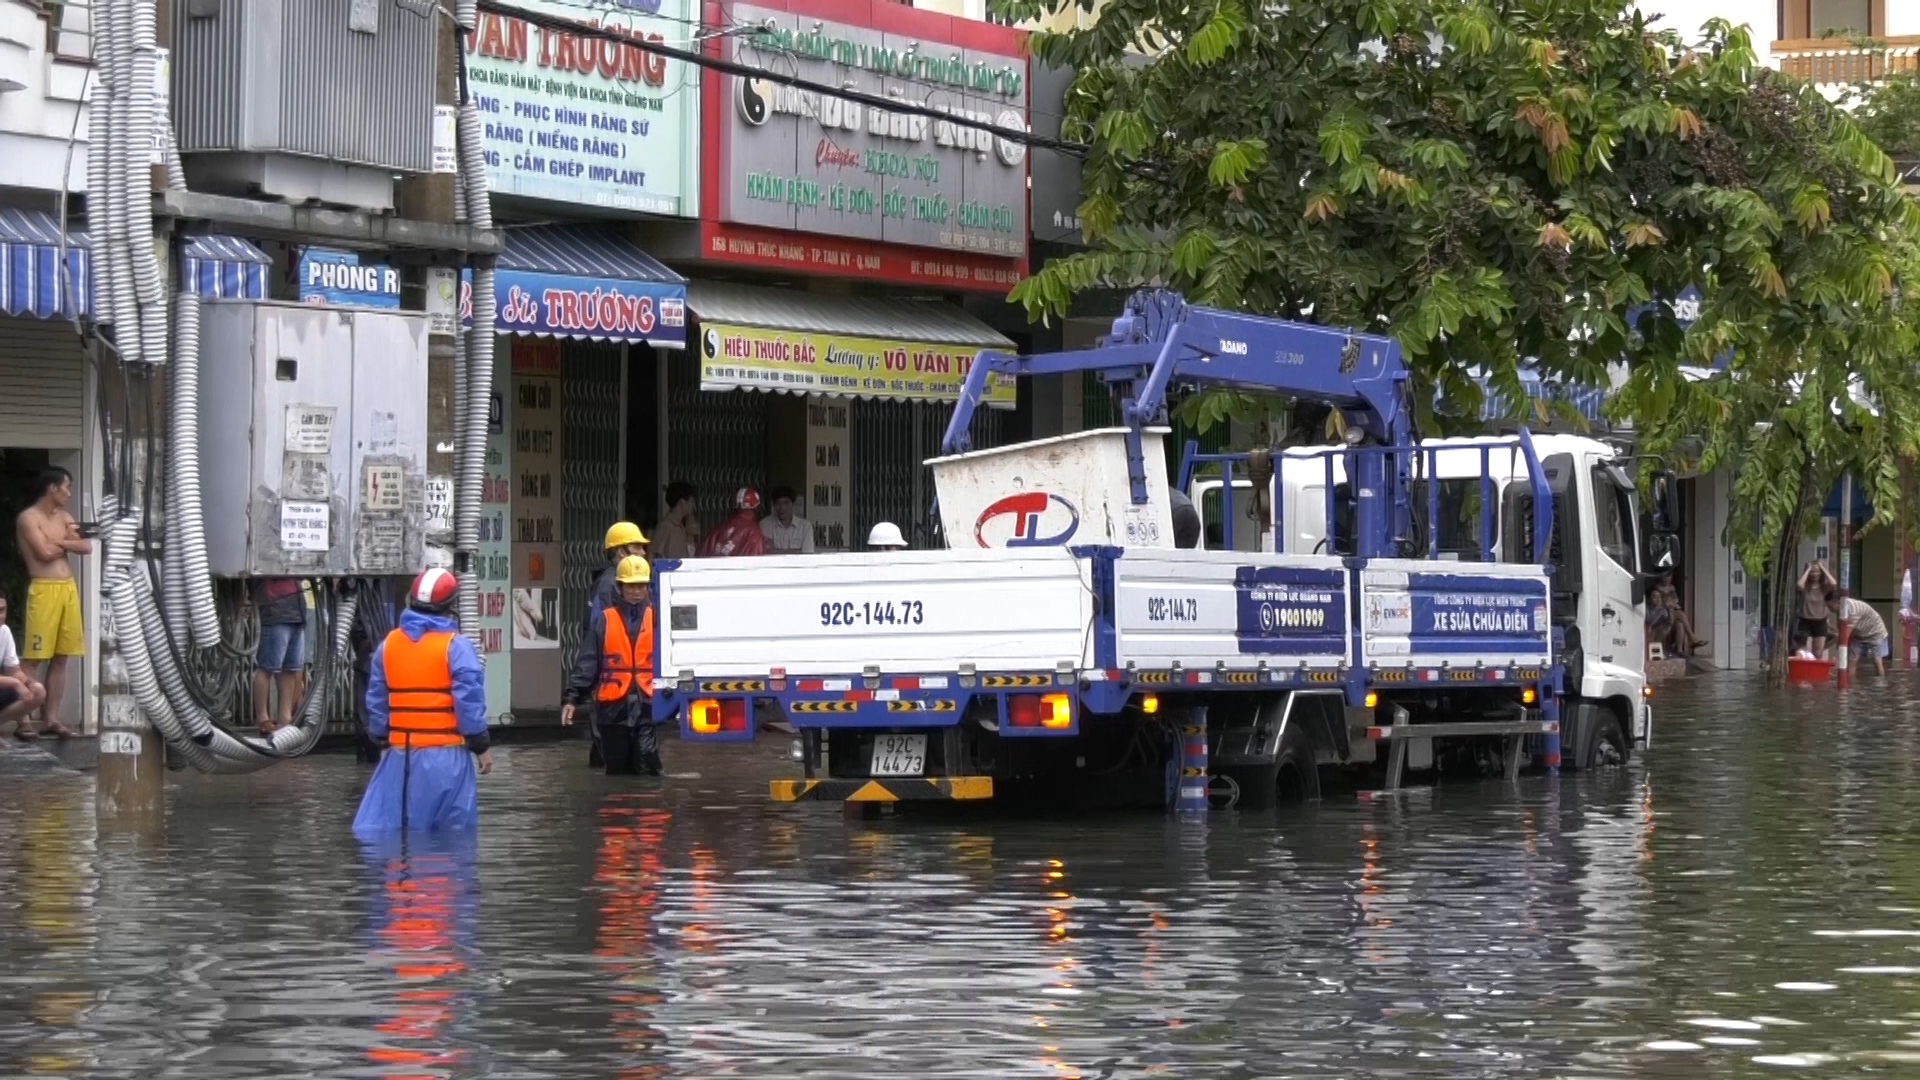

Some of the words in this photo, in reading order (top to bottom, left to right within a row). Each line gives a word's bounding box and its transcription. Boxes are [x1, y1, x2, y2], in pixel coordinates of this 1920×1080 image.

[472, 91, 500, 113] ĂNG
[514, 101, 551, 123] PHỤC
[555, 106, 587, 127] HÌNH
[591, 112, 627, 133] RĂNG
[631, 118, 650, 137] SỨ
[485, 122, 523, 144] RĂNG
[583, 136, 619, 158] RĂNG
[483, 150, 500, 167] NG
[549, 158, 584, 178] GHÉP
[588, 164, 646, 187] IMPLANT
[864, 148, 909, 178] KHOA
[913, 152, 940, 186] NỘI
[745, 168, 782, 202] KHÁM
[785, 172, 818, 208] BỆNH
[911, 192, 948, 224] THUỐC
[309, 258, 378, 292] PHÒNG
[384, 268, 401, 295] R
[543, 285, 655, 334] TRƯƠNG
[724, 335, 751, 361] HIỆU
[754, 337, 790, 362] THUỐC
[793, 338, 816, 363] BẮC
[824, 343, 864, 371] Lương
[883, 348, 907, 371] VÕ
[913, 350, 950, 373] VĂN
[955, 355, 975, 375] TH
[820, 600, 924, 626] 92C-144.73
[1148, 596, 1198, 622] 92C-144.73
[1274, 607, 1325, 627] 19001909
[1433, 611, 1448, 631] XE
[1449, 606, 1472, 631] SỬA
[1472, 607, 1503, 631] CHỮA
[1503, 608, 1528, 634] ĐIỆN
[33, 634, 42, 651] 2
[886, 736, 914, 754] 92C
